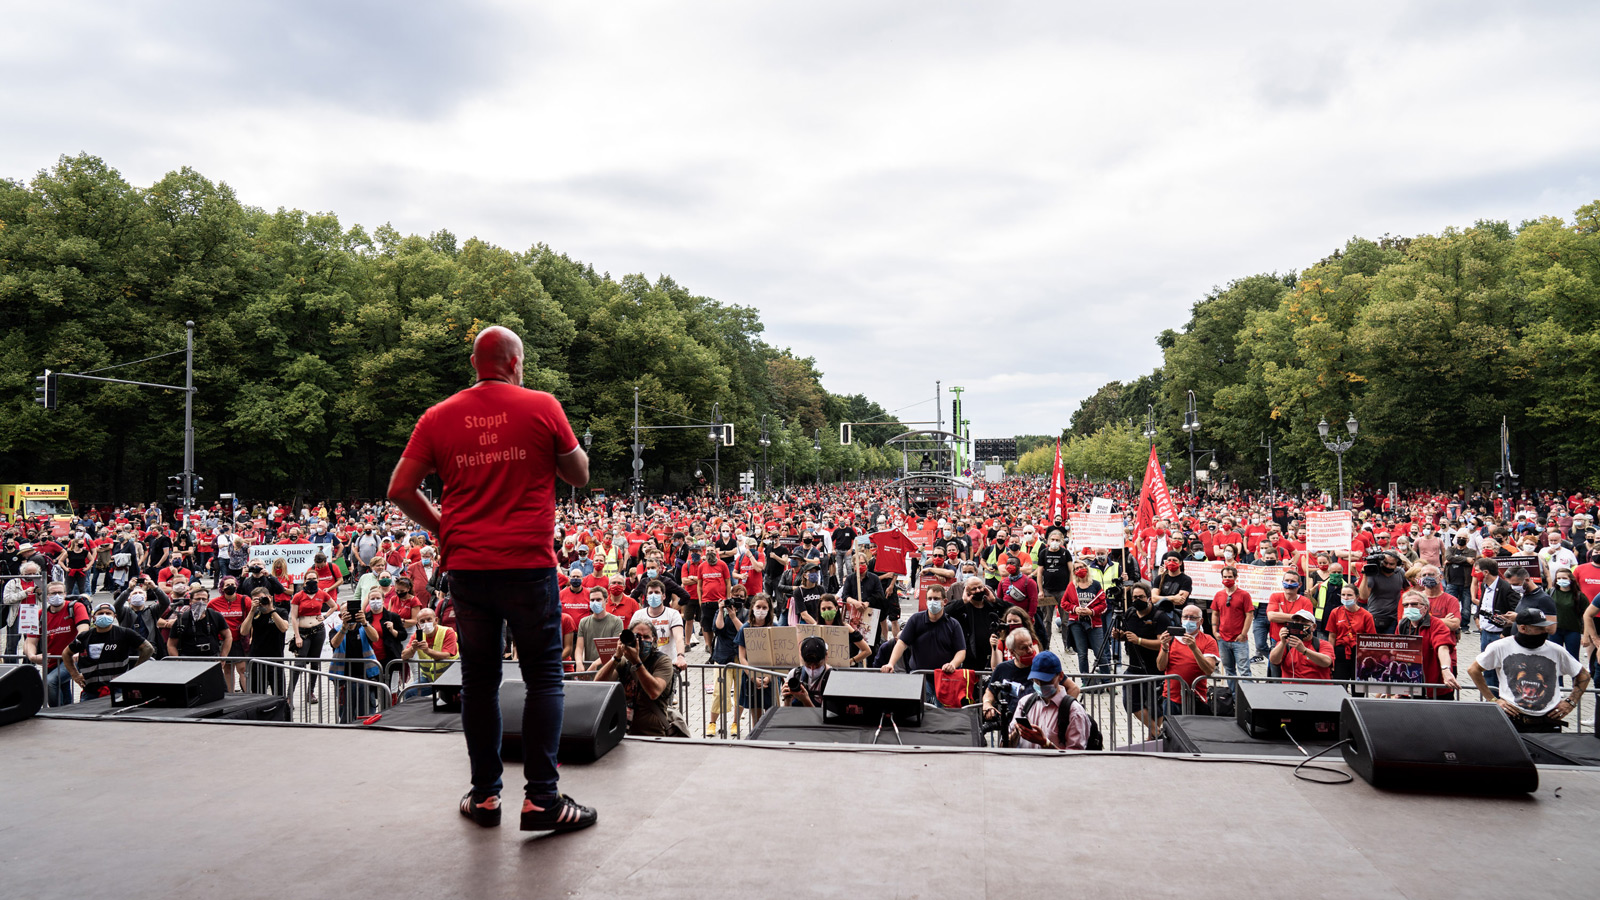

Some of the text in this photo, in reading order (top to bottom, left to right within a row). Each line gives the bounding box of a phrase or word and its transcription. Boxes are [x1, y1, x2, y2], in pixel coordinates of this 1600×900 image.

[464, 411, 508, 429] Stoppt
[479, 431, 498, 446] die
[456, 446, 526, 469] Pleitewelle
[281, 548, 313, 556] Spuncer
[804, 593, 820, 602] adida
[826, 627, 840, 636] THE
